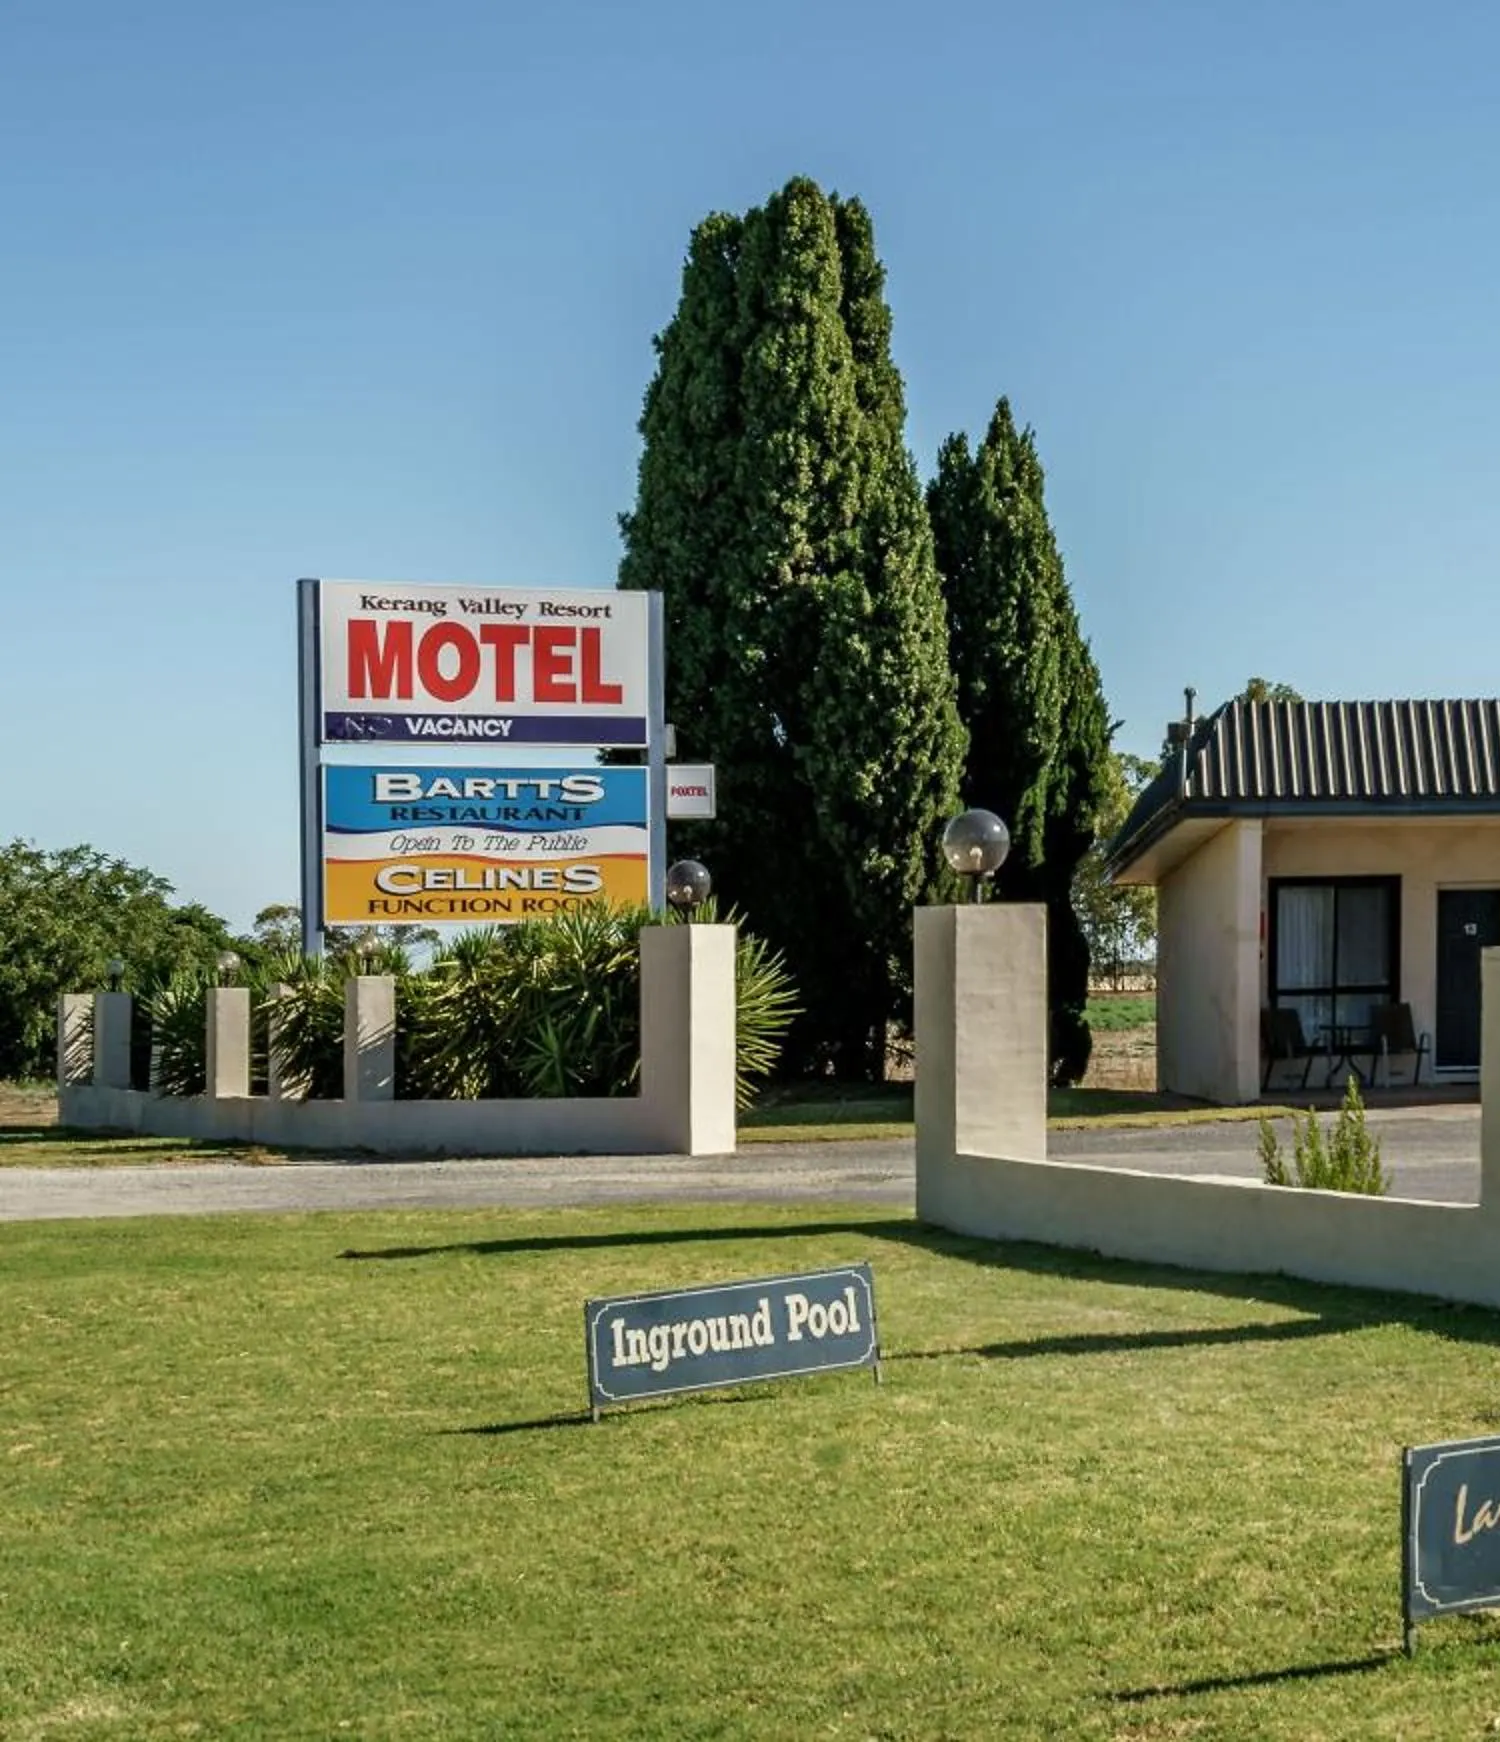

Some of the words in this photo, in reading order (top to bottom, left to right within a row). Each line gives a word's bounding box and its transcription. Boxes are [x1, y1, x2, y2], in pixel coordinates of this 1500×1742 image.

[360, 595, 447, 617] Kerang
[458, 598, 528, 619] Valley
[539, 601, 612, 619] Resort
[347, 618, 623, 705] MOTEL
[405, 716, 513, 737] VACANCY
[390, 805, 586, 821] RESTAURANT
[389, 834, 441, 855] Open
[452, 834, 475, 851] To
[484, 834, 519, 851] The
[527, 835, 589, 852] Public
[368, 898, 512, 915] FUNCTION
[611, 1297, 775, 1373] Inground
[785, 1286, 861, 1342] Pool
